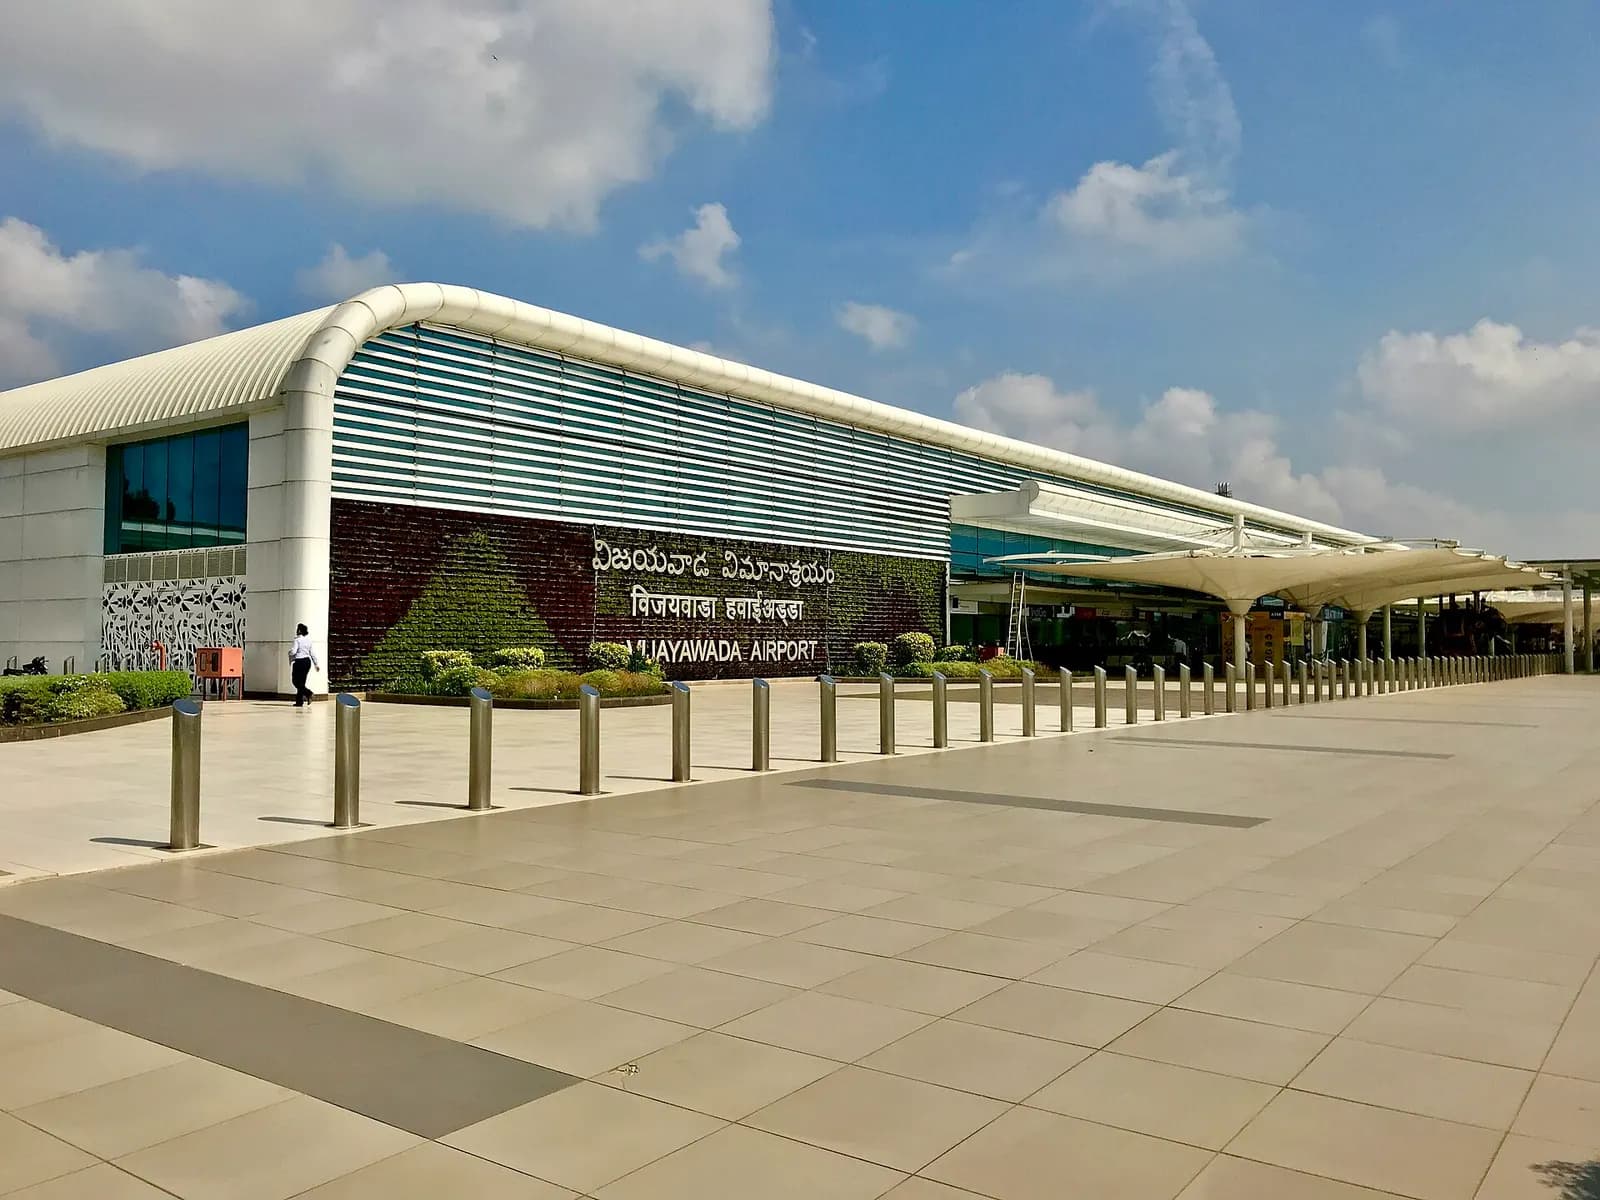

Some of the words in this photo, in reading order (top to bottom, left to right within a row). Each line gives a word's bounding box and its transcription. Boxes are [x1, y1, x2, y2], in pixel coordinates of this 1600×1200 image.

[592, 539, 709, 577] విజయవాడ
[722, 550, 835, 587] విమానాశ్రయం
[630, 584, 717, 619] विजयवाडा
[750, 640, 818, 662] AIRPORT
